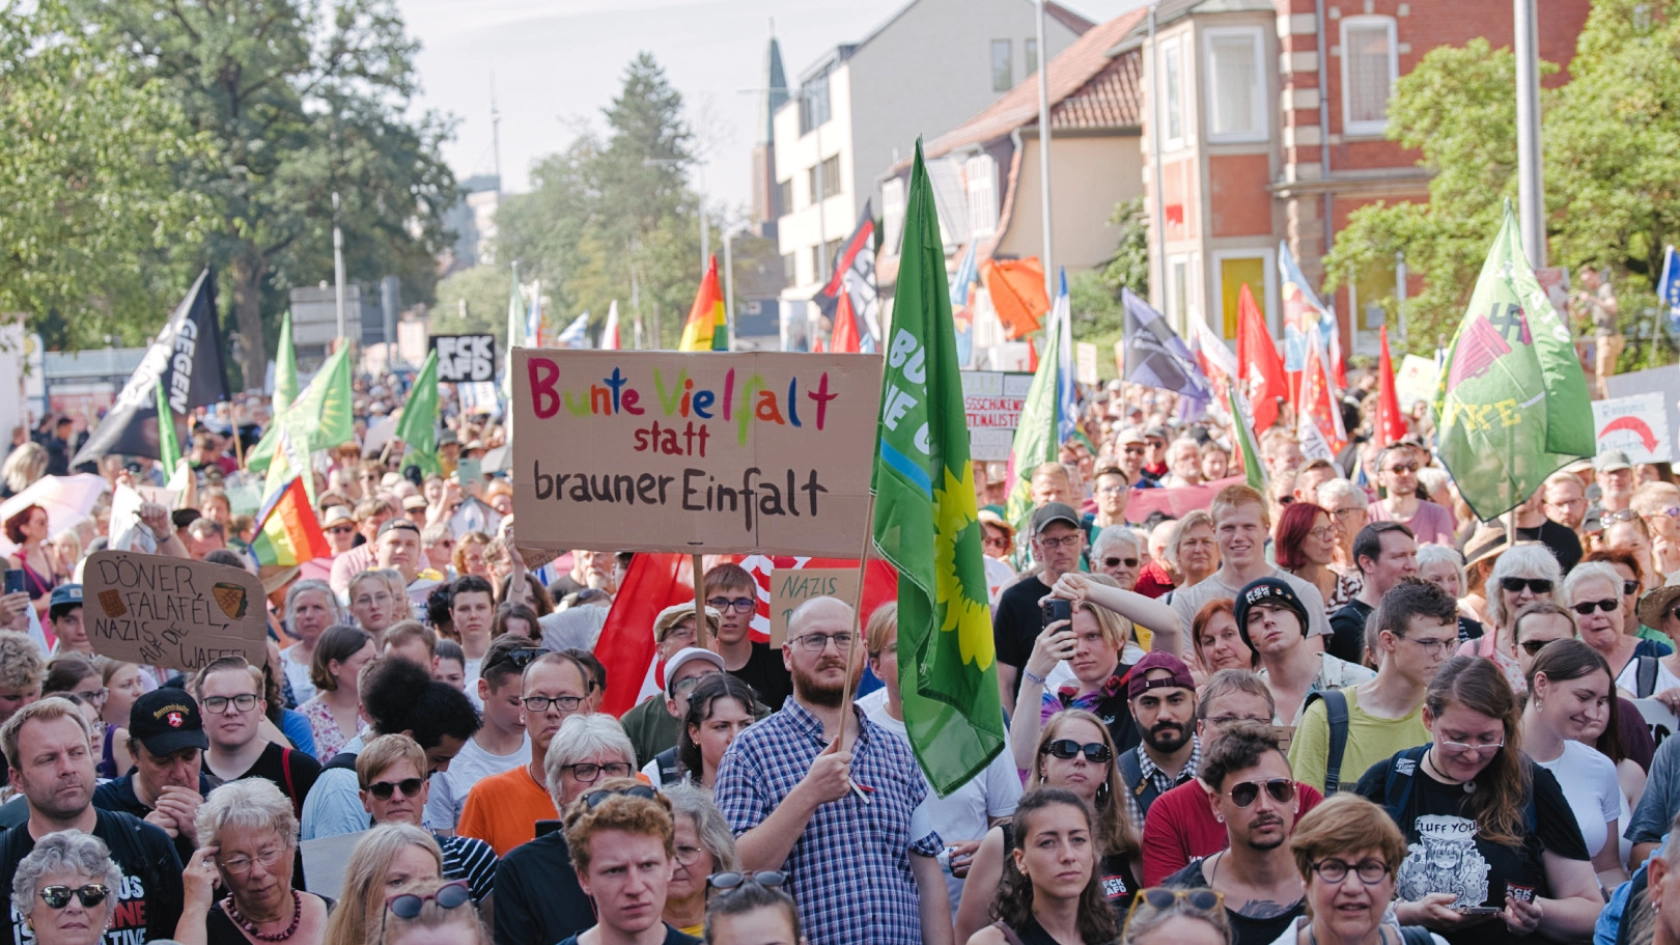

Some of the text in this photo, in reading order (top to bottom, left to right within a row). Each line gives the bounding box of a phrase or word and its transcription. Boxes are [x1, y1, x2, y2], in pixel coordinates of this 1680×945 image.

[437, 336, 493, 359] FCK
[170, 318, 198, 415] GEGEN
[436, 356, 492, 380] AFD
[527, 358, 839, 447] Bunte Vielfalt
[633, 420, 711, 457] statt
[534, 459, 829, 532] brauner Einfalt
[780, 575, 838, 599] NAZIS
[95, 618, 156, 646] NAZIS
[139, 621, 190, 663] AUF DIE
[1451, 820, 1476, 833] YOU
[119, 875, 145, 900] US
[1102, 878, 1124, 889] FCK
[1106, 885, 1127, 896] AFD
[1506, 885, 1533, 896] FCK
[103, 927, 147, 945] TIVE
